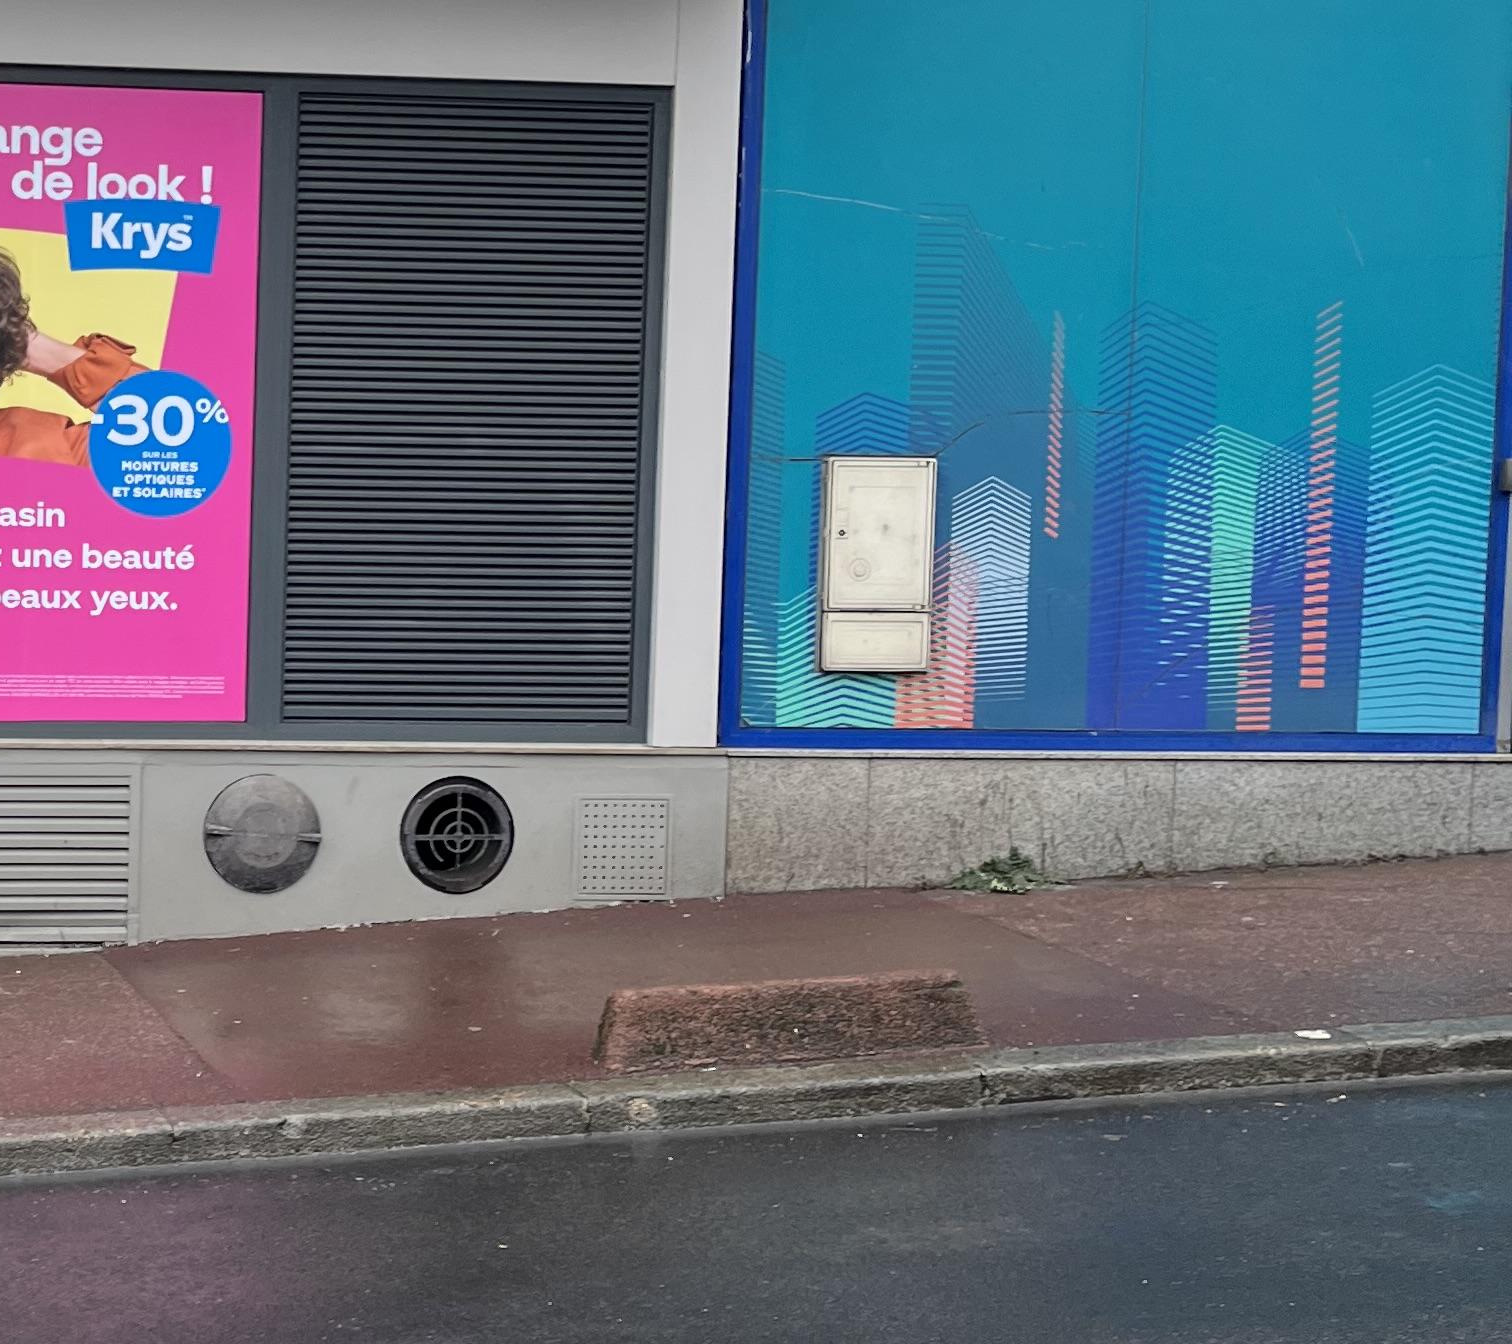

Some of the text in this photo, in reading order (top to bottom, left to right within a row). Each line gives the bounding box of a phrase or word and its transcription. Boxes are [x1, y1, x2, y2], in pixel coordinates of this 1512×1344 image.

[11, 159, 214, 204] de look !
[91, 212, 193, 259] Krys
[91, 394, 230, 447] -30%
[121, 461, 199, 473] MONTURES
[142, 451, 178, 459] SUR LES
[112, 487, 130, 498] ET
[124, 474, 195, 486] OPTIQUES
[11, 548, 74, 570] une
[82, 541, 195, 571] beauté
[91, 587, 178, 616] yeux.
